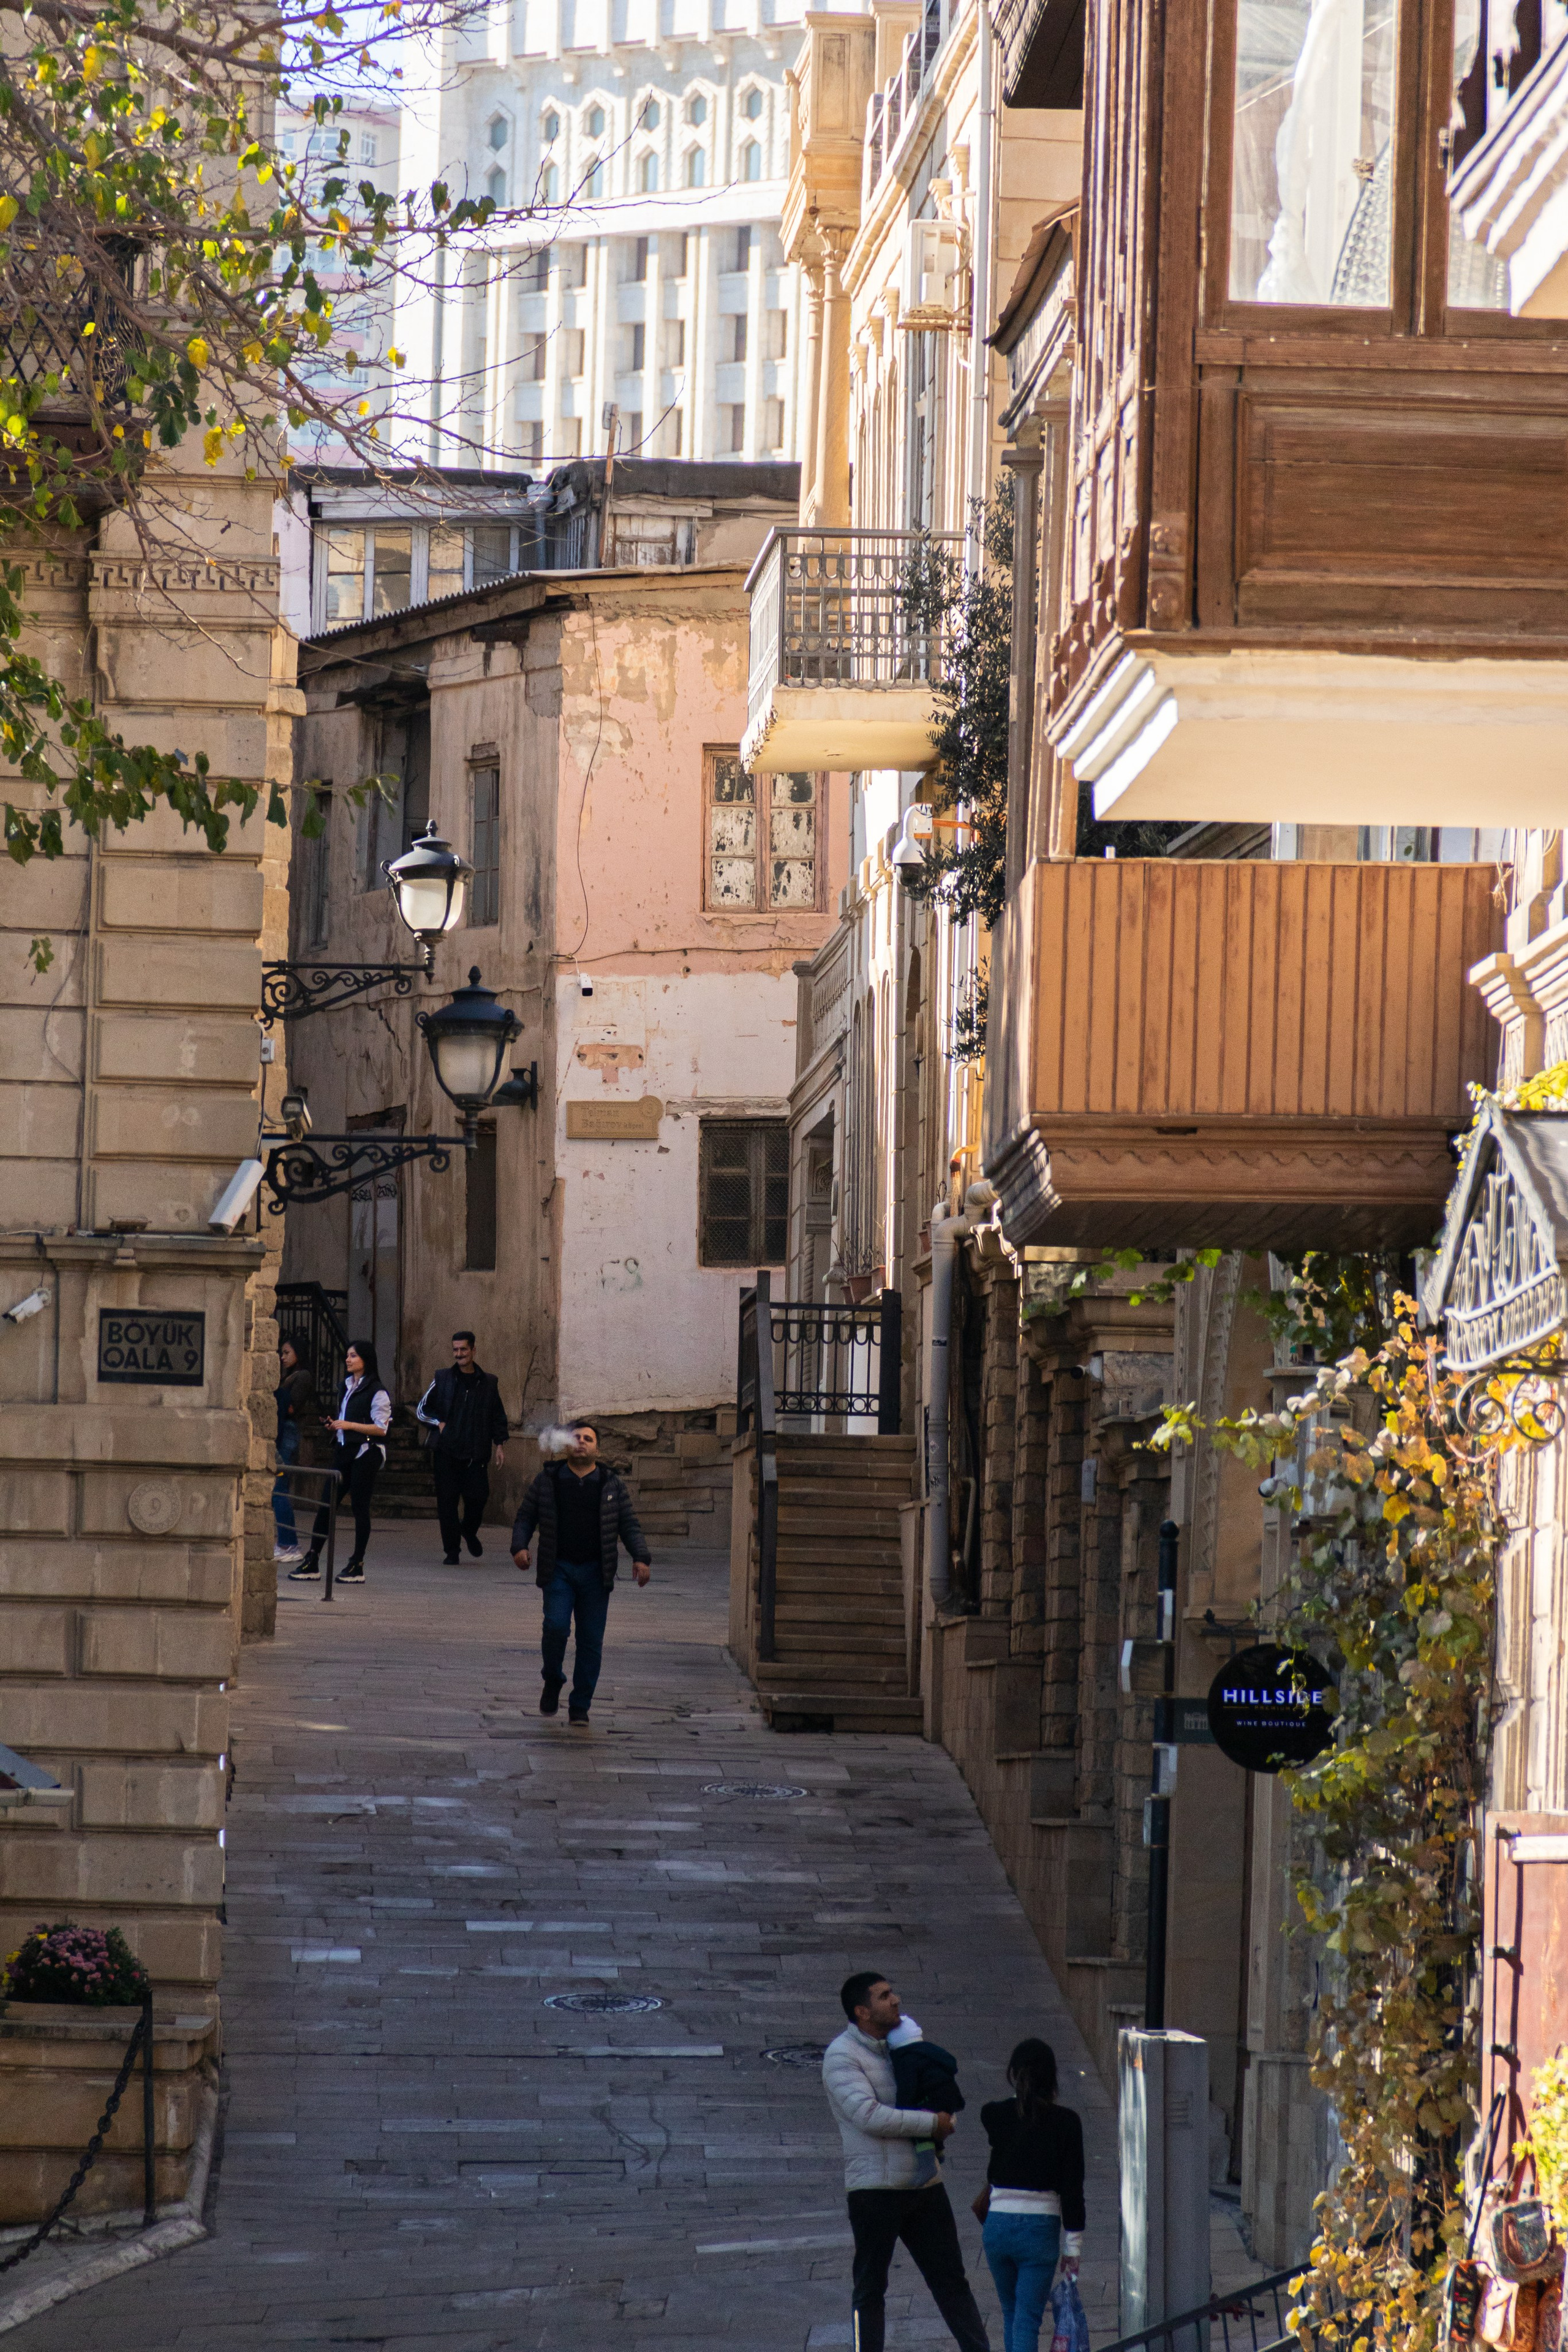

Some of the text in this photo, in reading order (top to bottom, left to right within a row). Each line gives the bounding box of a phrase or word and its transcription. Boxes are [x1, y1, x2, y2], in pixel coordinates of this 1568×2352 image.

[103, 1347, 199, 1371] QALA 9
[149, 1498, 162, 1517] 9
